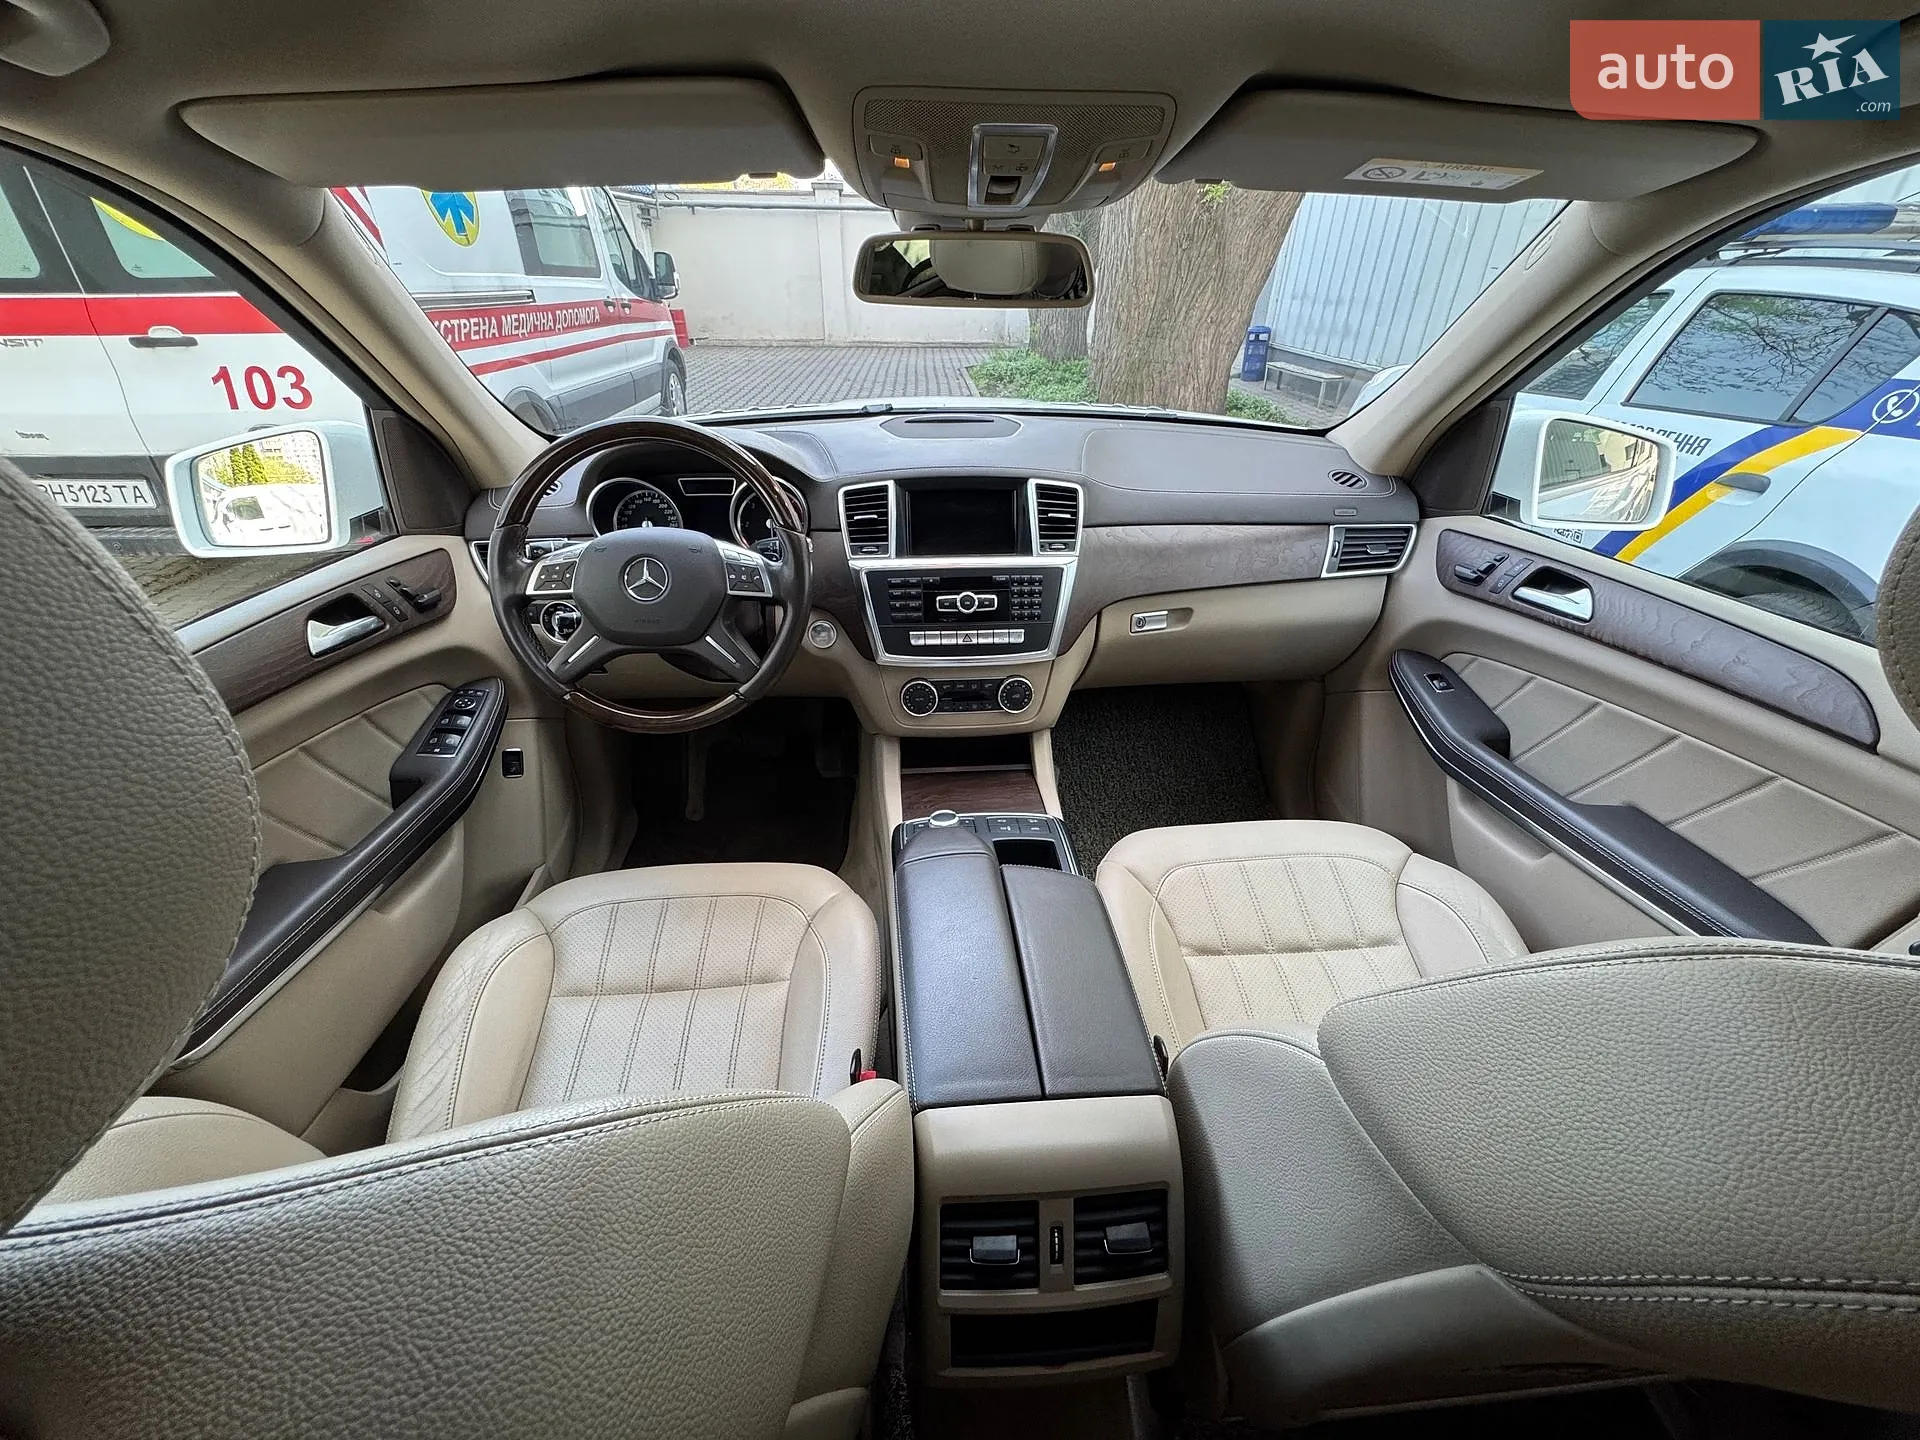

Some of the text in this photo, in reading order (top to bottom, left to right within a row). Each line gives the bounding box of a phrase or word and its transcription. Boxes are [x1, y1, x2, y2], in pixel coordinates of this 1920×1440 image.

[501, 311, 554, 338] МЕДИЧНА
[555, 306, 600, 333] ДОПОМОГА
[211, 365, 313, 410] 103
